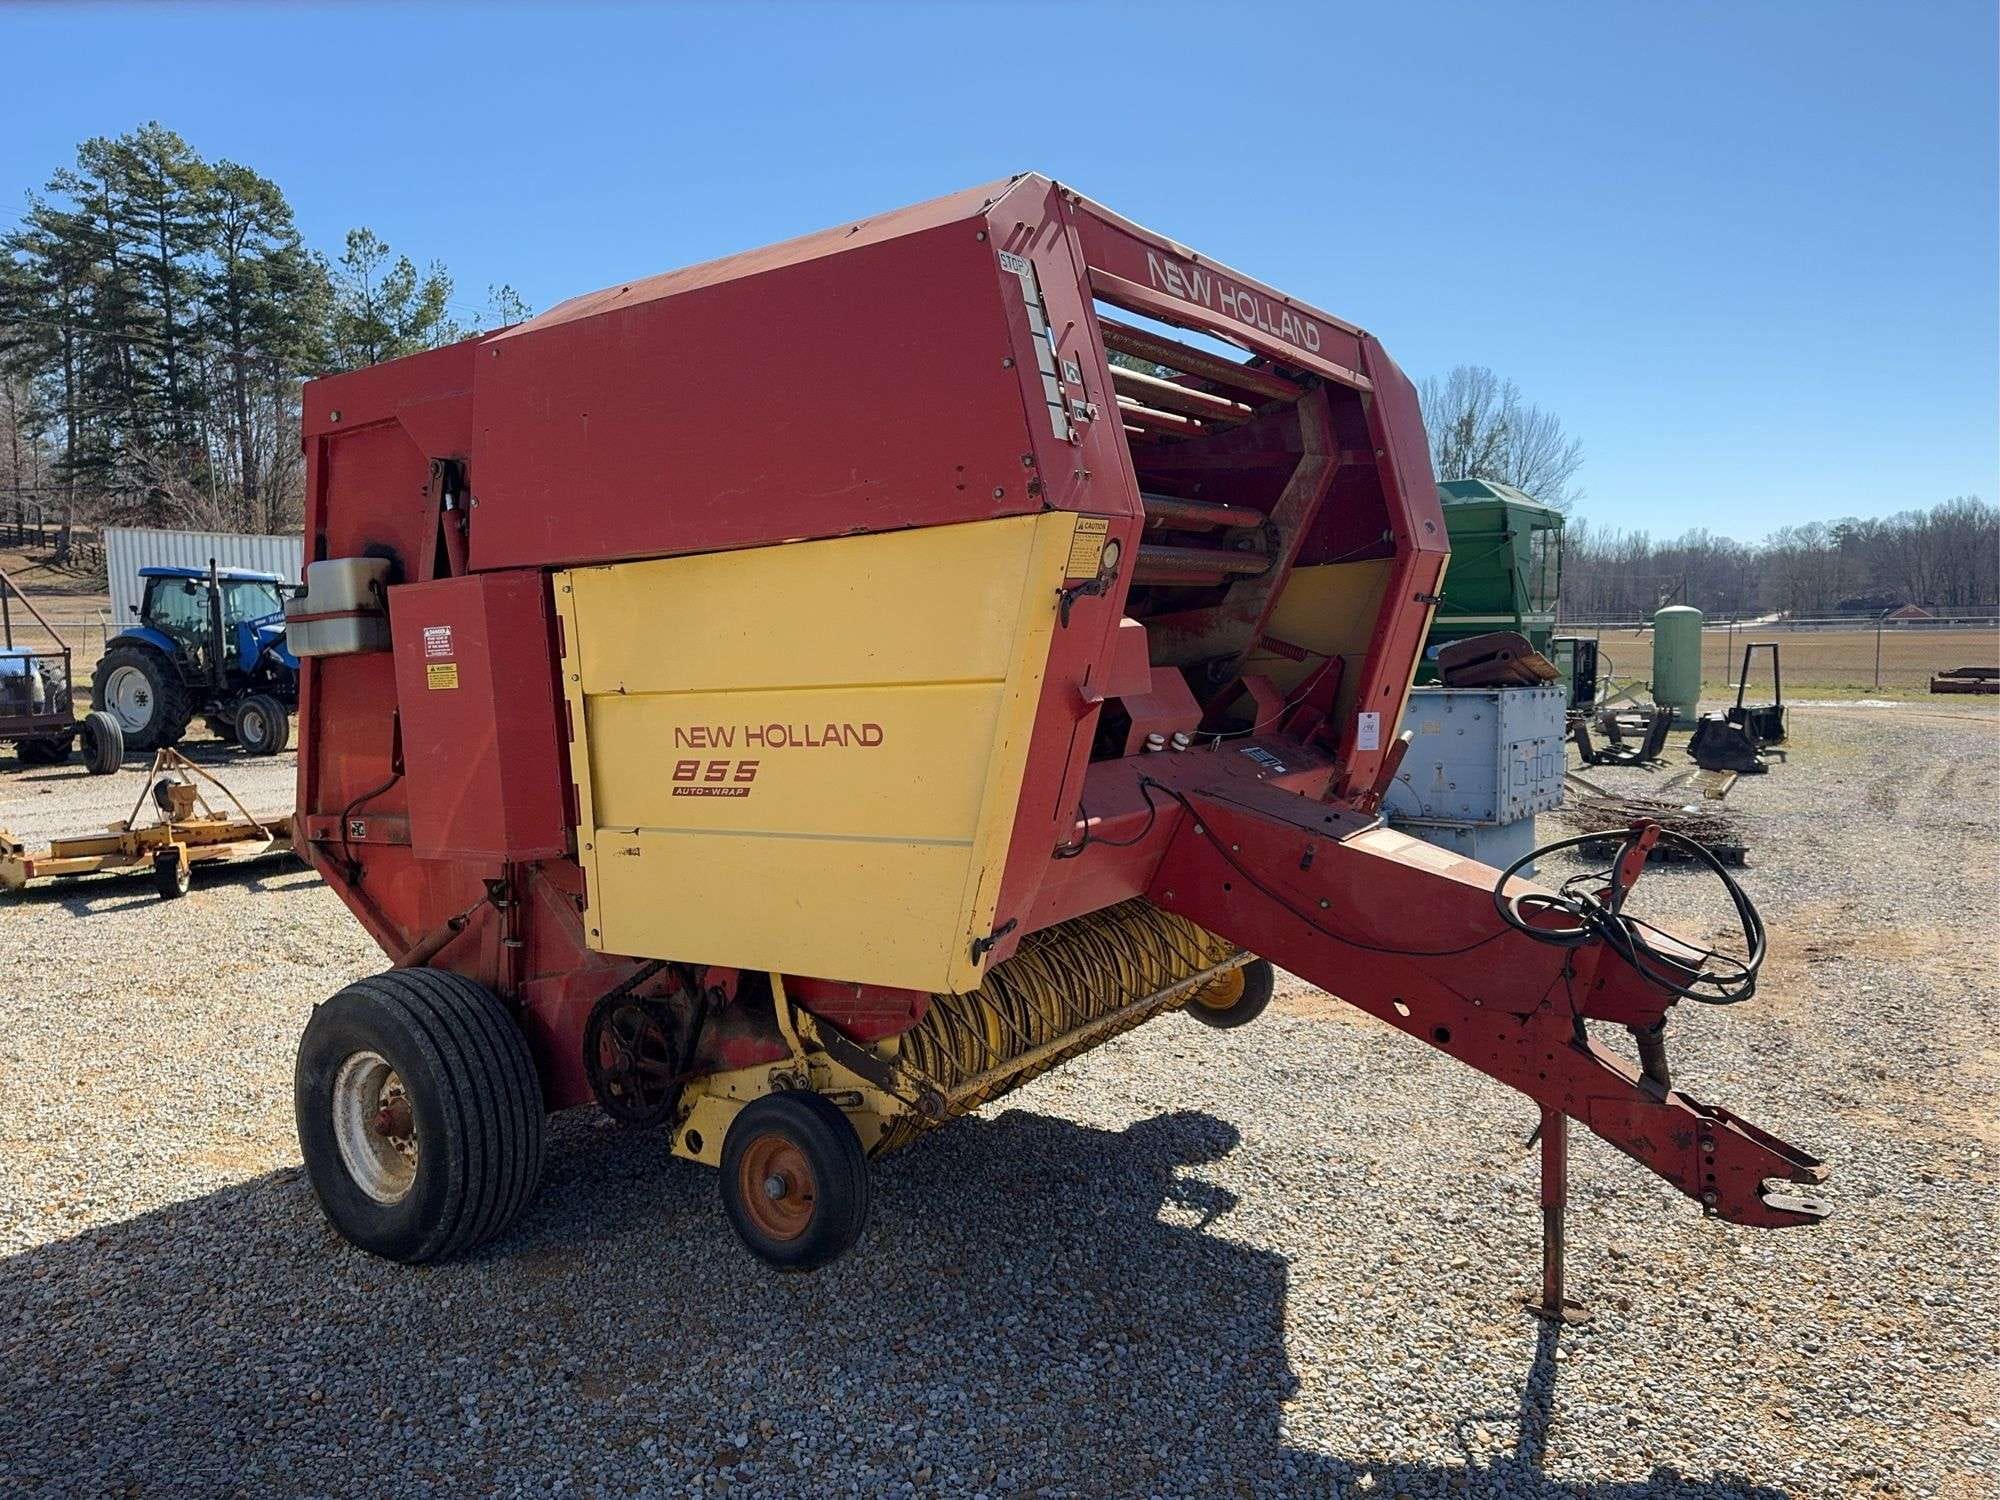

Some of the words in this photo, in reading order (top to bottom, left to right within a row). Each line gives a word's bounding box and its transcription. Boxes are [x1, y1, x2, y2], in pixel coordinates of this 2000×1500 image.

[1000, 253, 1024, 272] STOP
[1146, 252, 1210, 306] NEW
[1217, 281, 1320, 351] HOLLAND
[1084, 521, 1106, 530] CAUTION
[675, 725, 736, 748] NEW
[744, 723, 883, 748] HOLLAND
[672, 760, 760, 782] 855
